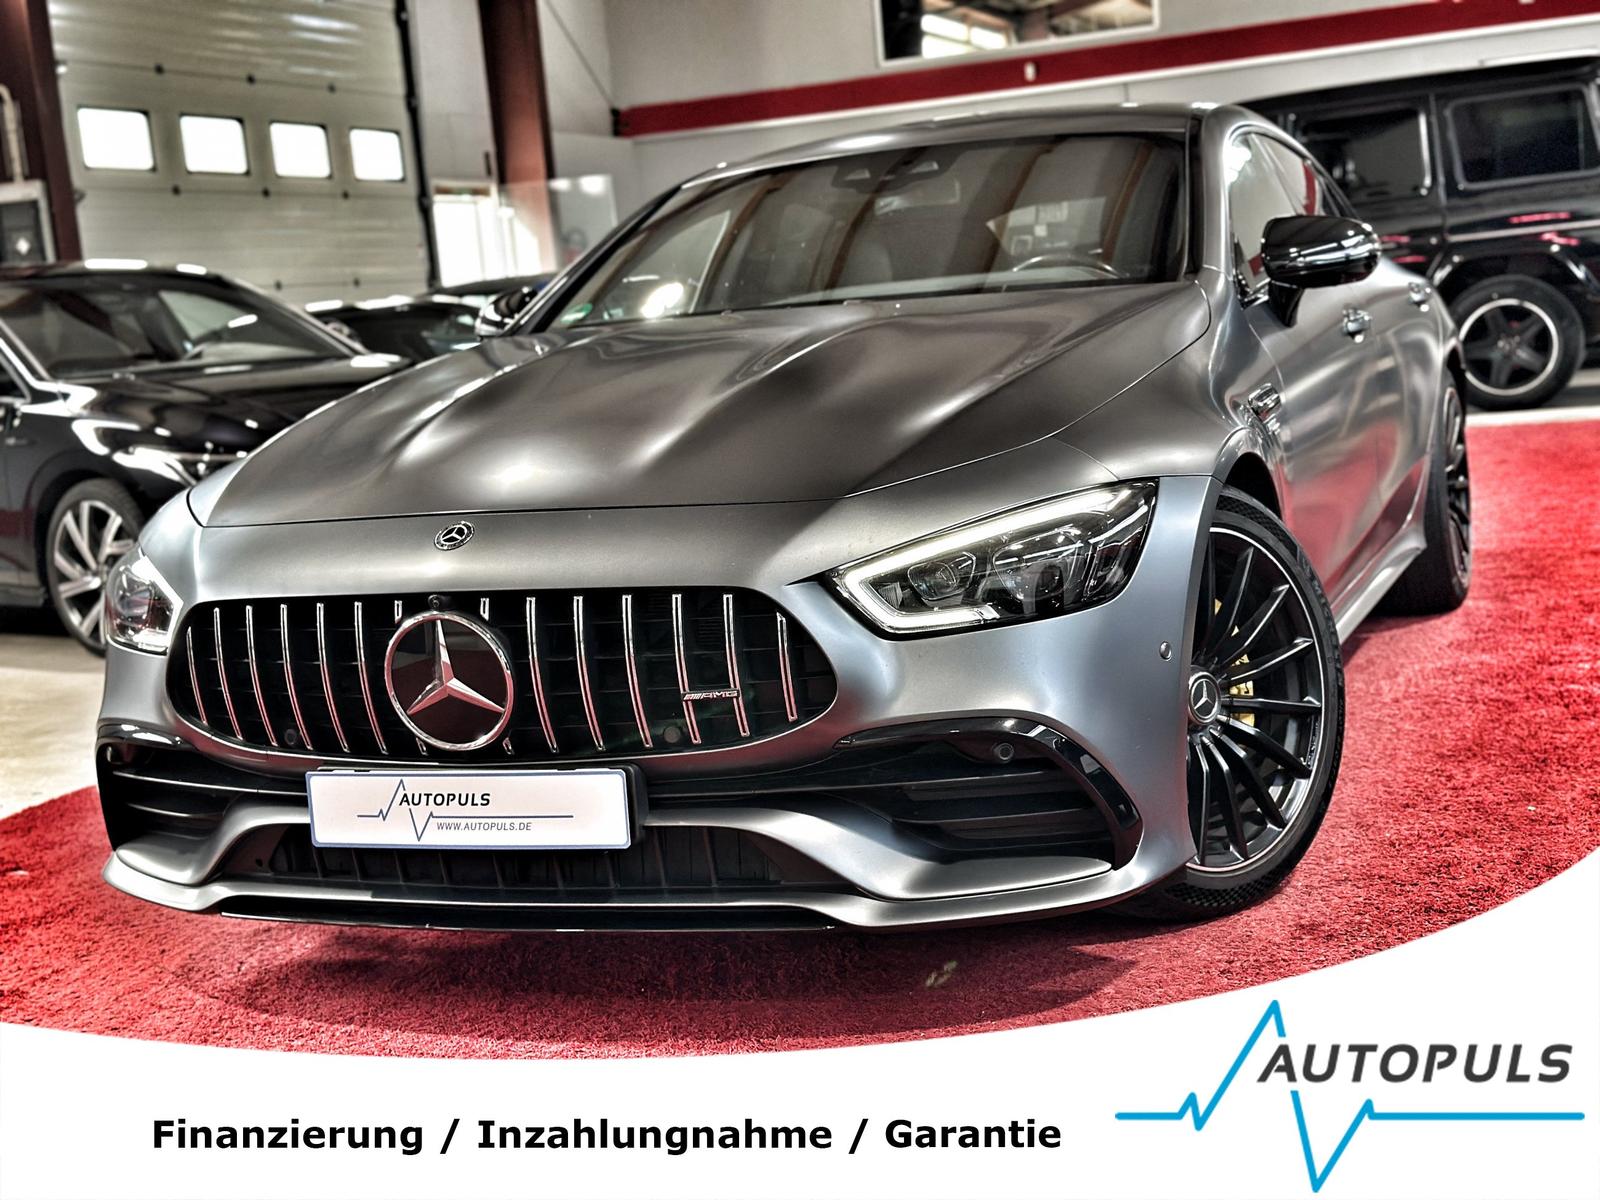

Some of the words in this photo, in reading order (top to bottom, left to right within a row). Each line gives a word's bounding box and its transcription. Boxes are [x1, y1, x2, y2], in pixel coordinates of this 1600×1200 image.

[699, 690, 738, 700] AMG
[399, 793, 491, 807] AUTOPULS
[437, 822, 532, 831] WWW.AUTOPULS.DE
